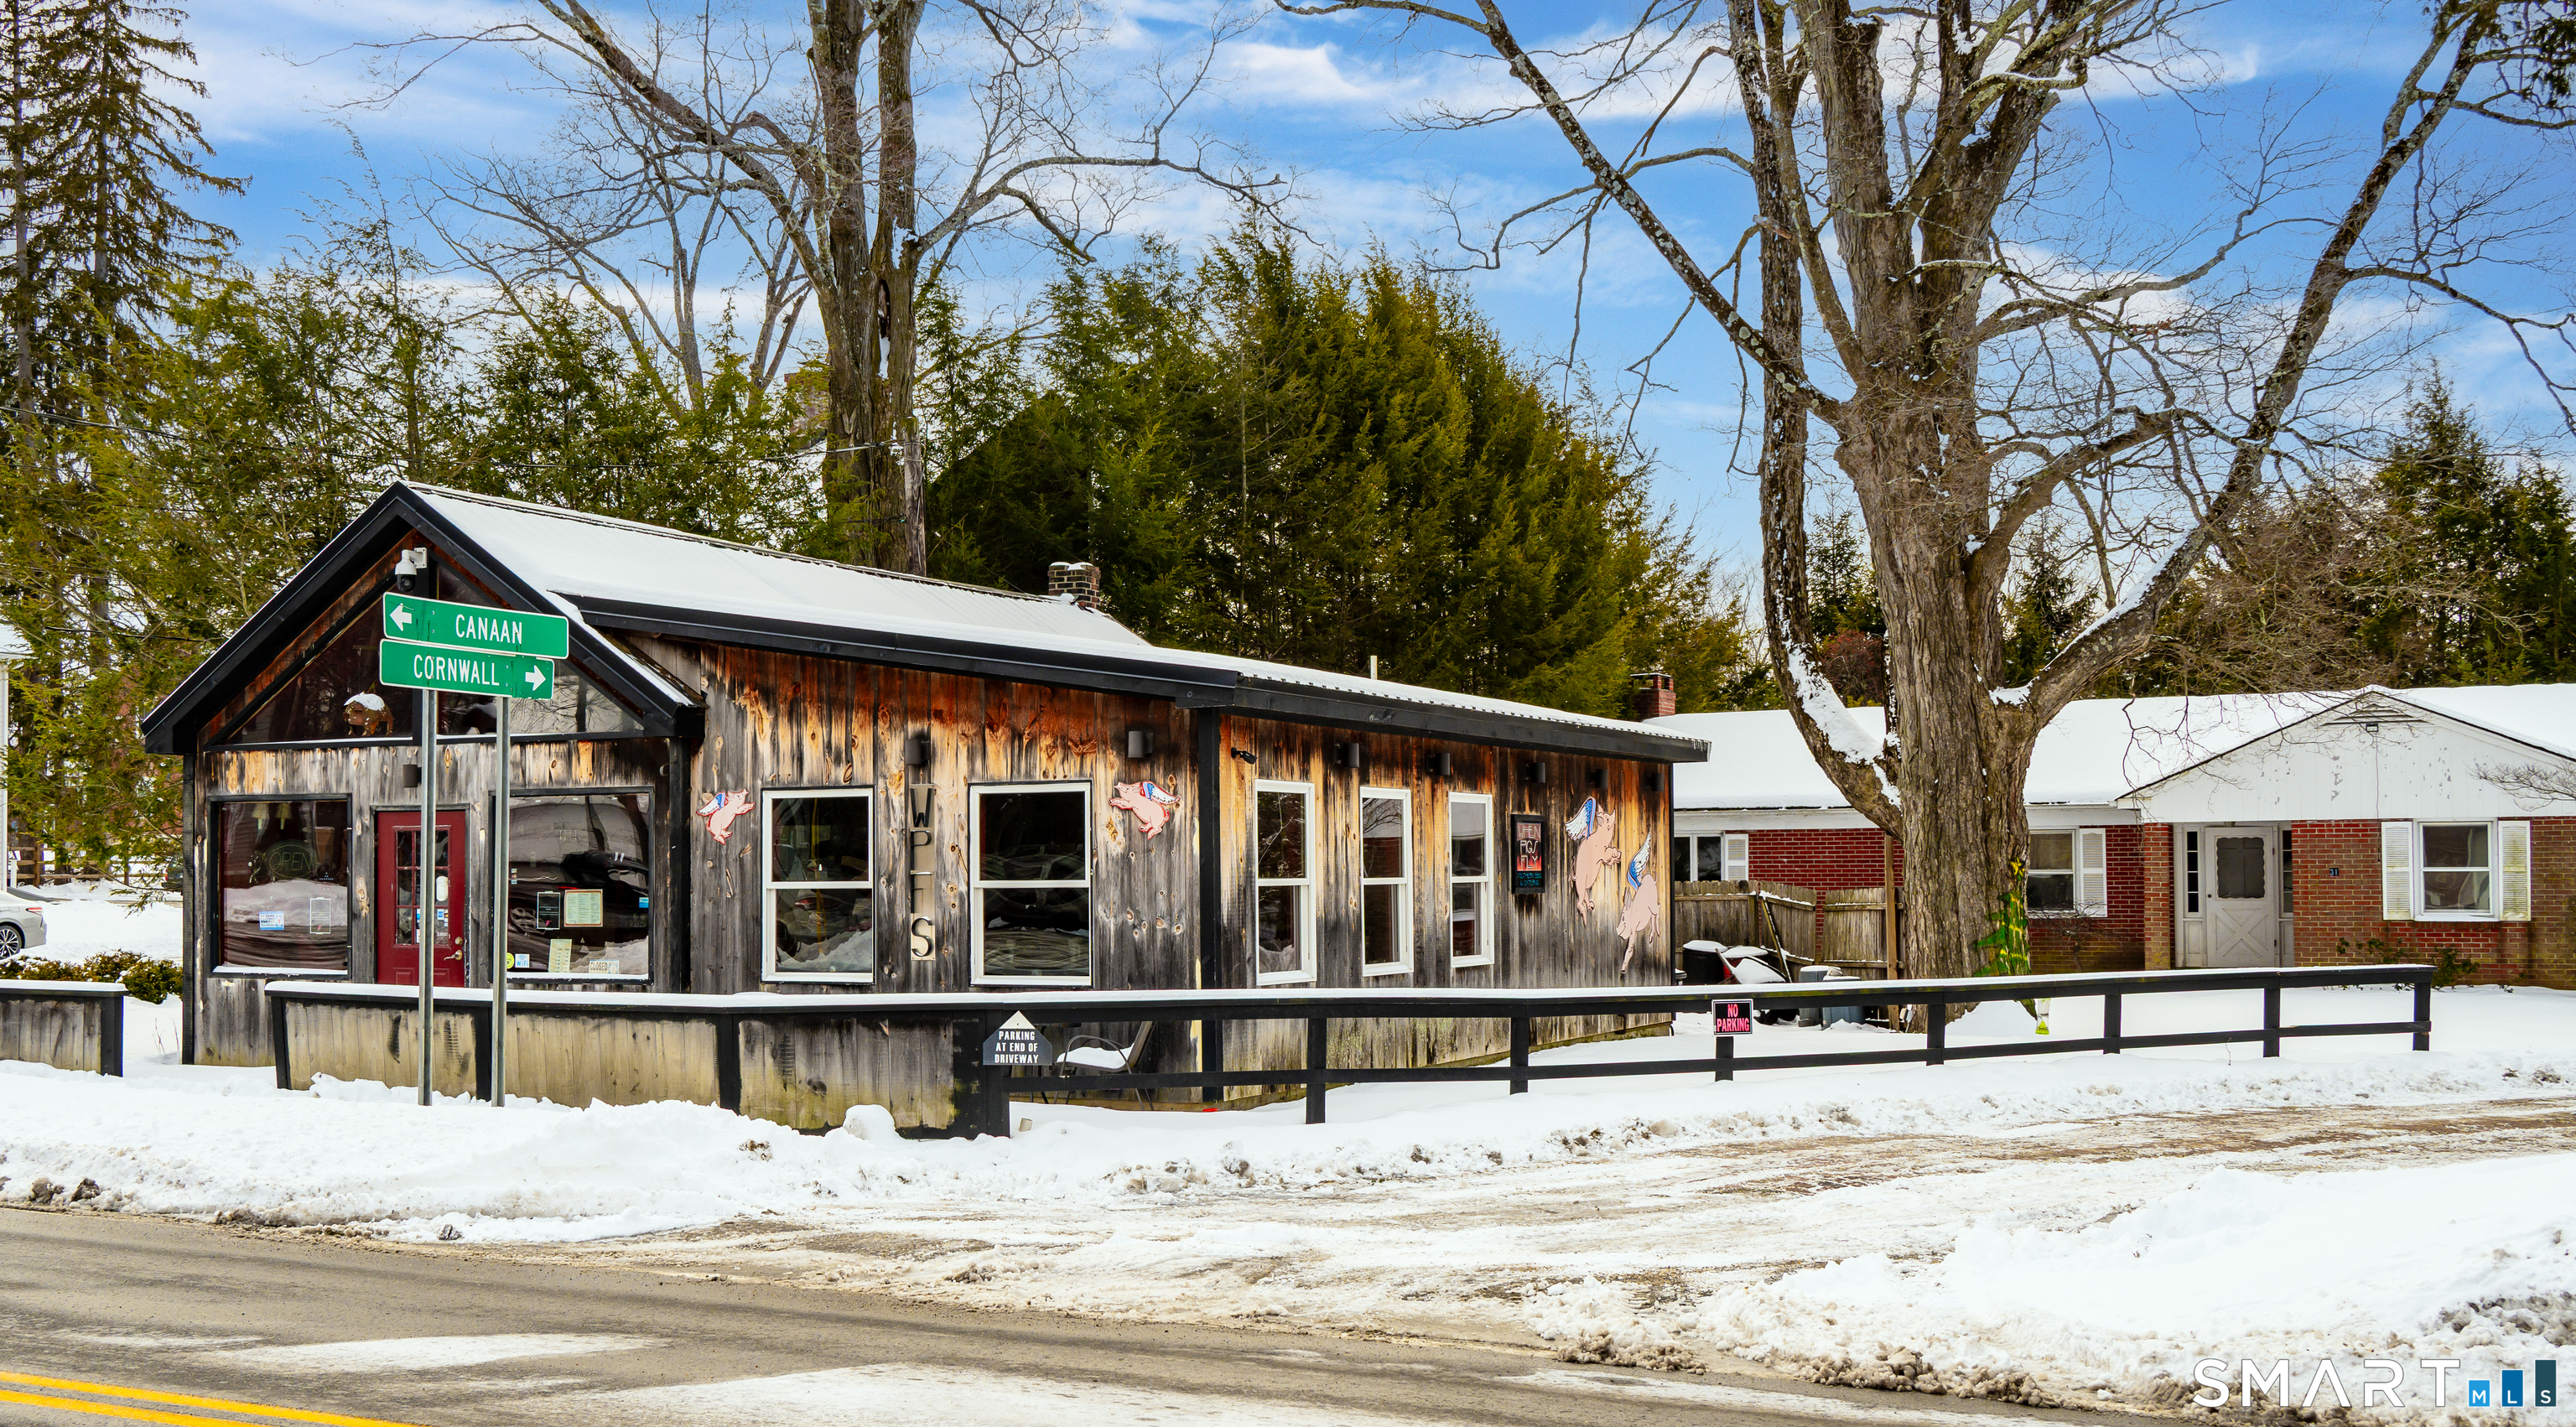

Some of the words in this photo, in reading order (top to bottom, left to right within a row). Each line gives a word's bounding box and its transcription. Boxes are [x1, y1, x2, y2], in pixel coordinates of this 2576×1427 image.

[455, 614, 522, 645] CANAAN
[413, 654, 500, 686] CORNWALL
[1518, 825, 1541, 838] WHEN
[1520, 840, 1538, 854] PIGS
[269, 851, 313, 871] OPEN
[1521, 855, 1538, 869] FLY
[261, 915, 276, 923] CLOSED
[589, 962, 608, 971] CLOSED
[1727, 1004, 1738, 1017] NO
[1716, 1018, 1749, 1031] PARKING
[998, 1030, 1036, 1040] PARKING
[995, 1042, 1006, 1052] AT
[1009, 1042, 1026, 1052] END
[1028, 1042, 1038, 1052] OF
[994, 1054, 1039, 1064] DRIVEWAY
